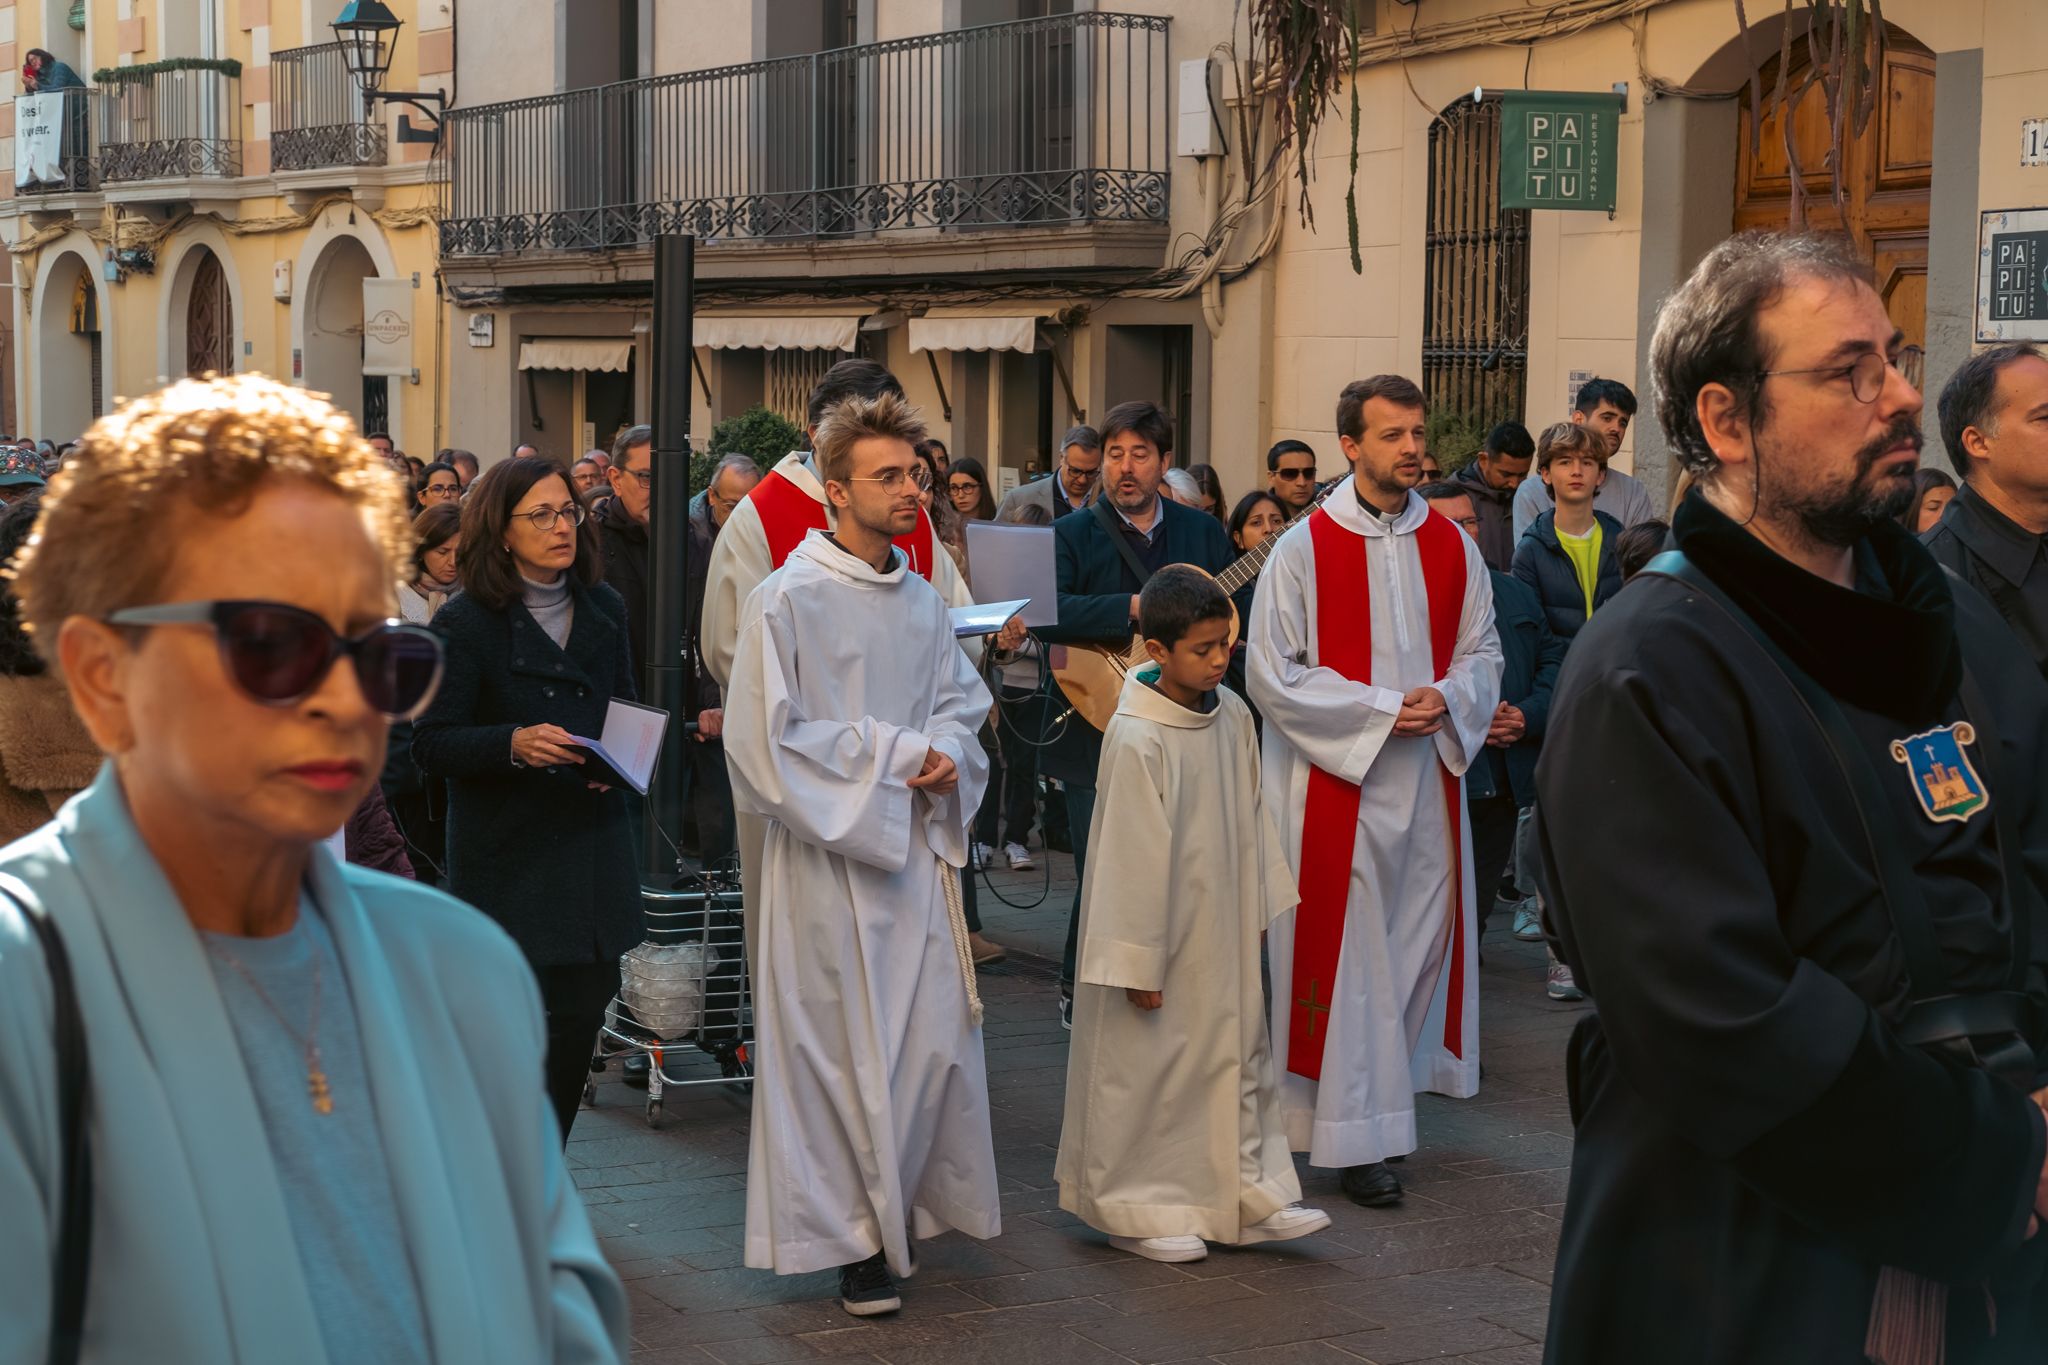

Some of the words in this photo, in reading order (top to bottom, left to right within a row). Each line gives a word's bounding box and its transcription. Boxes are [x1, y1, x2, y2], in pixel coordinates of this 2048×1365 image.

[1533, 117, 1578, 139] PA
[1533, 146, 1572, 168] PI
[1590, 113, 1598, 201] RESTAURANT
[1531, 175, 1576, 197] TU
[2000, 244, 2025, 264] PA
[2000, 270, 2021, 289] PI
[2029, 240, 2037, 317] RESTAURANT
[1999, 296, 2023, 315] TU
